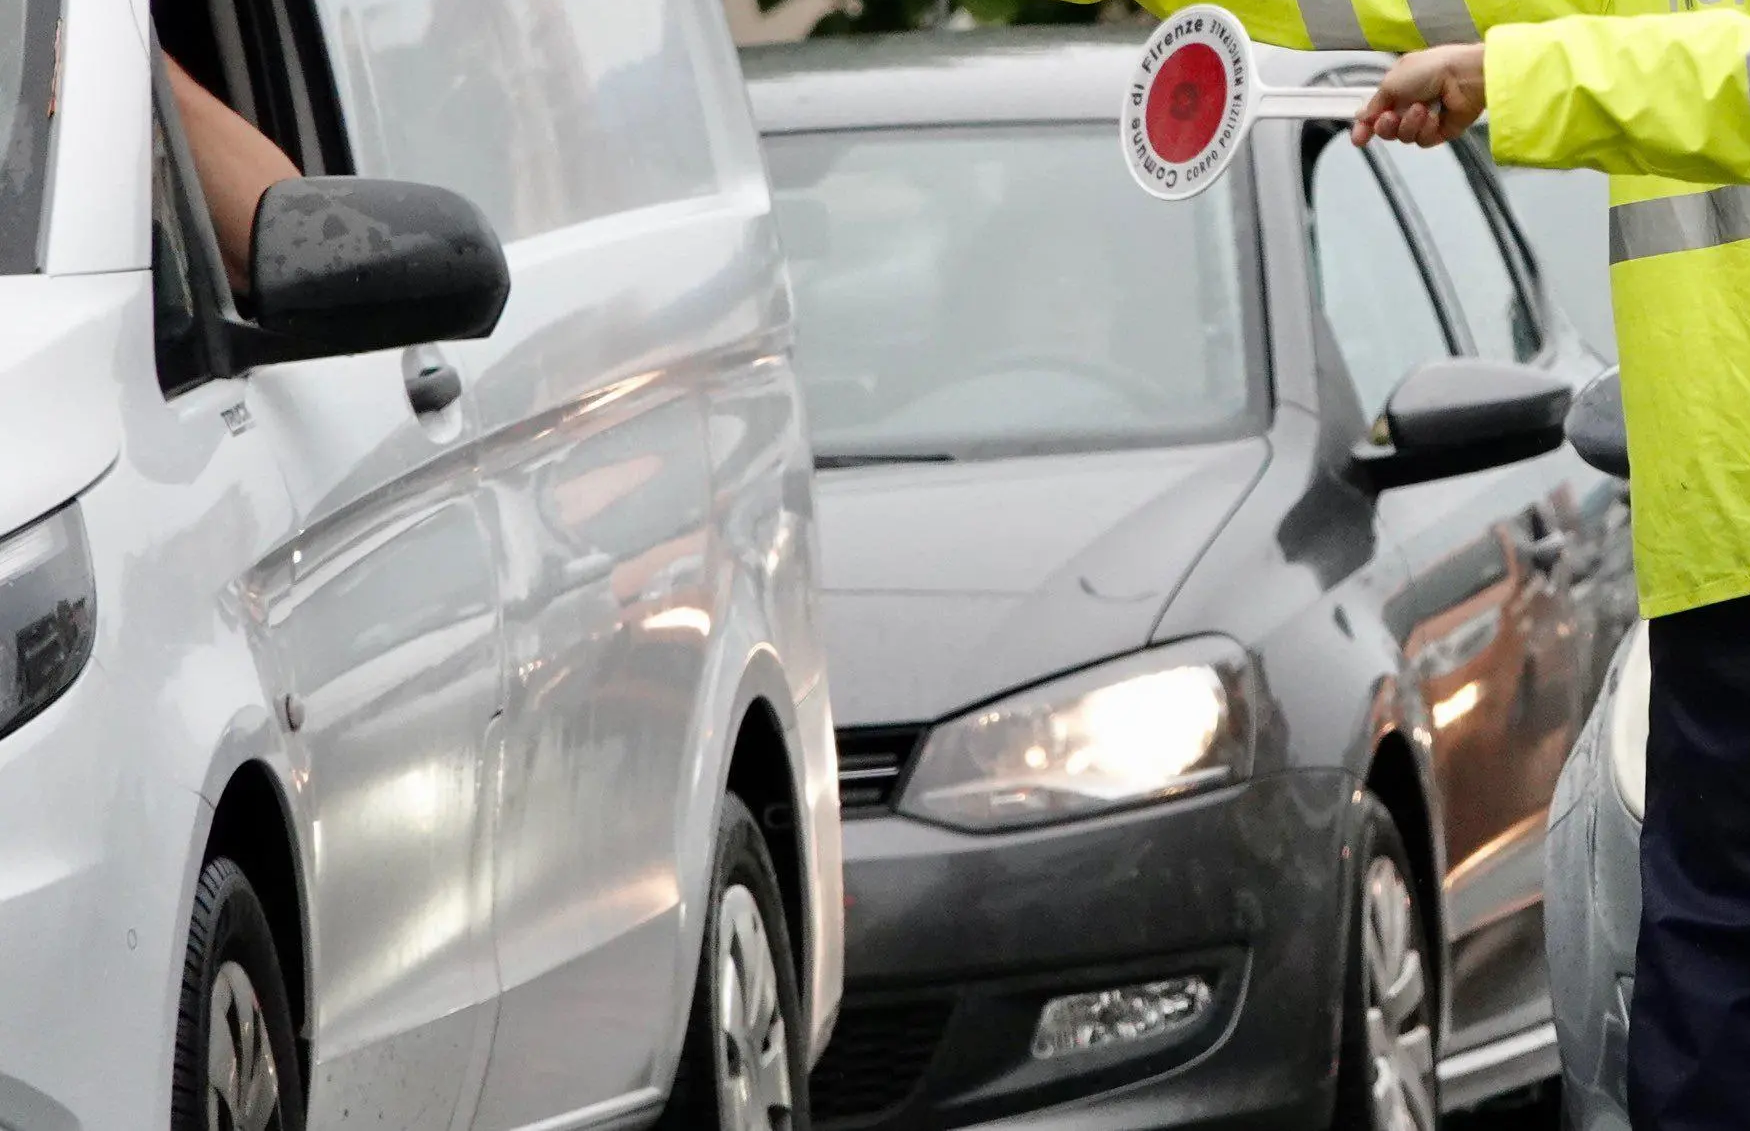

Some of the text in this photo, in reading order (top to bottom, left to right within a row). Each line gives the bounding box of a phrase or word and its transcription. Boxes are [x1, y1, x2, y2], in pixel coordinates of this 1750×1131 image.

[1131, 18, 1204, 189] Comune di Firenze
[1186, 149, 1219, 182] CORPO
[1218, 92, 1243, 149] POLIZIA
